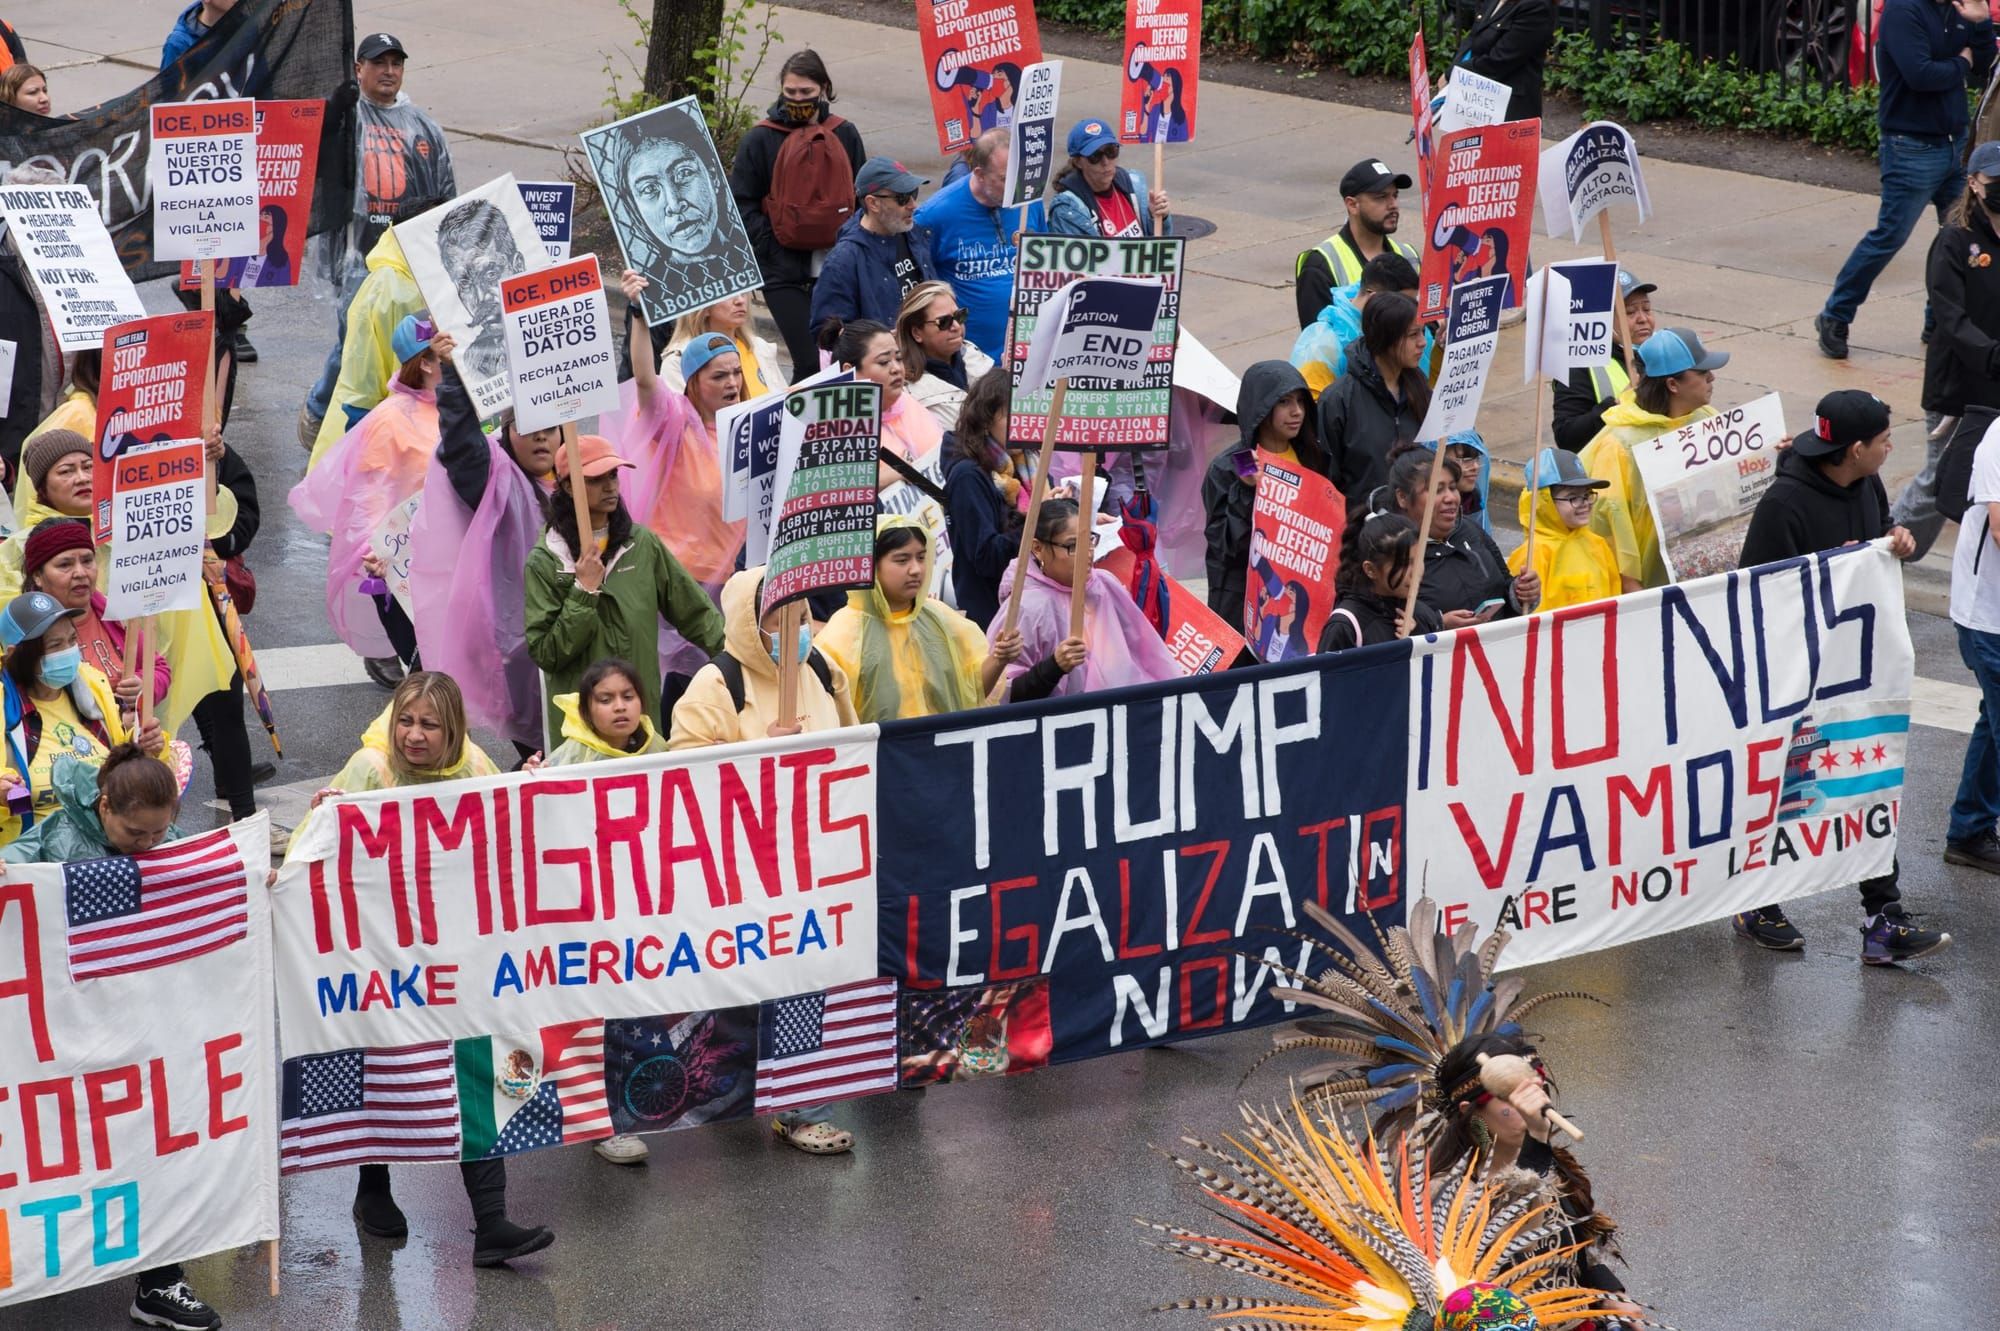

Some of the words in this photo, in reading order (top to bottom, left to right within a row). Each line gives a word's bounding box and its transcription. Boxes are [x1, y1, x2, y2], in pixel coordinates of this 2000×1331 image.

[934, 1, 968, 24] STOP
[1136, 0, 1159, 15] STOP
[936, 5, 1016, 38] DEPORTATIONS
[1135, 13, 1188, 28] DEPORTATIONS
[965, 19, 1018, 48] DEFEND
[1151, 28, 1188, 45] DEFEND
[941, 36, 1021, 72] IMMIGRANTS
[1134, 45, 1187, 63] IMMIGRANTS
[1032, 68, 1051, 83] END
[1025, 84, 1053, 101] LABOR
[1023, 101, 1053, 118] ABUSE!
[158, 116, 198, 134] ICE,
[203, 112, 251, 130] DHS:
[165, 142, 217, 155] FUERA
[222, 140, 243, 151] DE
[1452, 140, 1467, 149] FIGHT
[1467, 137, 1480, 147] FEAR
[1587, 139, 1596, 152] A
[1600, 135, 1620, 148] LA
[168, 153, 242, 169] NUESTRO
[258, 160, 300, 179] EFEND
[1448, 149, 1481, 173] STOP
[169, 166, 242, 187] DATOS
[1446, 164, 1522, 188] DEPORTATIONS
[1616, 172, 1626, 182] A
[1, 190, 58, 211] MONEY
[56, 190, 92, 209] FOR:
[160, 196, 254, 211] RECHAZAMOS
[525, 191, 563, 203] INVEST
[1468, 182, 1520, 205] DEFEND
[27, 214, 76, 228] HEALTHCARE
[199, 212, 216, 221] LA
[532, 212, 566, 224] RKING
[1442, 201, 1517, 227] IMMIGRANTS
[34, 229, 71, 243] HOUSING
[169, 222, 245, 236] VIGILANCIA
[41, 245, 85, 258] EDUCATION
[1024, 239, 1110, 272] STOP
[1119, 242, 1177, 274] THE
[37, 269, 67, 285] NOT
[68, 269, 98, 284] FOR:
[61, 288, 81, 299] WAR
[508, 284, 546, 306] ICE,
[550, 271, 597, 294] DHS:
[653, 280, 728, 319] ABOLISH
[724, 269, 758, 294] ICE
[1460, 286, 1494, 306] ¡INVIERTE
[67, 301, 118, 313] DEPORTATIONS
[518, 306, 570, 328] FUERA
[574, 298, 595, 315] DE
[1461, 307, 1488, 324] CLASE
[73, 315, 112, 327] CORPORATE
[522, 312, 595, 341] NUESTRO
[1455, 322, 1490, 339] OBRERA!
[525, 326, 596, 358] DATOS
[1082, 335, 1143, 356] END
[1447, 340, 1493, 364] PAGAMOS
[113, 346, 146, 374] STOP
[519, 352, 609, 384] RECHAZAMOS
[1144, 362, 1172, 376] AND
[112, 361, 187, 391] DEPORTATIONS
[557, 374, 573, 386] LA
[135, 379, 185, 409] DEFEND
[531, 380, 604, 406] VIGILANCIA
[1119, 391, 1152, 404] RIGHTS
[1155, 391, 1170, 402] TO
[1439, 381, 1465, 401] ¡PAGA
[1467, 375, 1479, 390] LA
[814, 388, 875, 421] THE
[1011, 401, 1088, 416] UNIOIZE
[1097, 404, 1106, 417] &
[1116, 402, 1170, 417] STRIKE
[1442, 394, 1468, 411] TUYA!
[110, 402, 183, 438] IMMIGRANTS
[804, 419, 875, 442] GENDA!
[1011, 416, 1065, 430] DEFED
[1071, 418, 1149, 431] EDUCATION
[1156, 417, 1169, 429] &
[1678, 426, 1695, 442] DE
[1702, 408, 1743, 435] MAYO
[811, 435, 878, 456] EXPAND
[1009, 429, 1089, 442] ACAEMIC
[1098, 430, 1169, 443] FREEDOM
[1682, 422, 1764, 469] 2006
[120, 465, 153, 485] ICE,
[158, 457, 200, 478] DHS:
[818, 449, 878, 474] RIGHTS
[805, 465, 874, 485] PALESTINE
[805, 480, 823, 493] TO
[827, 474, 874, 490] ISRAEL
[1265, 464, 1283, 479] FIGHT
[1282, 471, 1298, 485] FEAR
[125, 491, 172, 510] FUERA
[176, 485, 194, 500] DE
[820, 487, 874, 506] CRIMES
[1259, 476, 1299, 506] STOP
[126, 501, 193, 524] NUESTRO
[845, 506, 875, 520] AND
[1256, 496, 1334, 544] DEPORTATIONS
[127, 515, 193, 542] DATOS
[823, 517, 874, 533] RIGHTS
[816, 531, 855, 549] RIGHTS
[859, 529, 873, 542] TO
[1276, 523, 1329, 564] DEFEND
[116, 544, 199, 569] RECHAZAMOS
[800, 552, 809, 563] &
[817, 542, 872, 560] STRIKE
[1255, 535, 1324, 583] IMMIGRANTS
[148, 564, 163, 576] LA
[781, 560, 856, 588] EDUCATION
[861, 558, 872, 569] &
[121, 572, 187, 595] VIGILANCIA
[802, 571, 872, 592] FREEDOM
[1661, 542, 1876, 746] NOS
[934, 671, 1320, 869] TRUMP
[1447, 737, 1785, 890] VAMOS
[310, 748, 871, 954] IMMIGRANTS
[1495, 866, 1577, 933] ARE
[1611, 859, 1698, 911] NOT
[1727, 799, 1898, 880] LEAVING!
[317, 964, 458, 1016] MAKE
[493, 932, 701, 996] AMERICA
[706, 903, 854, 968] GREAT
[1110, 939, 1315, 1047] NOW
